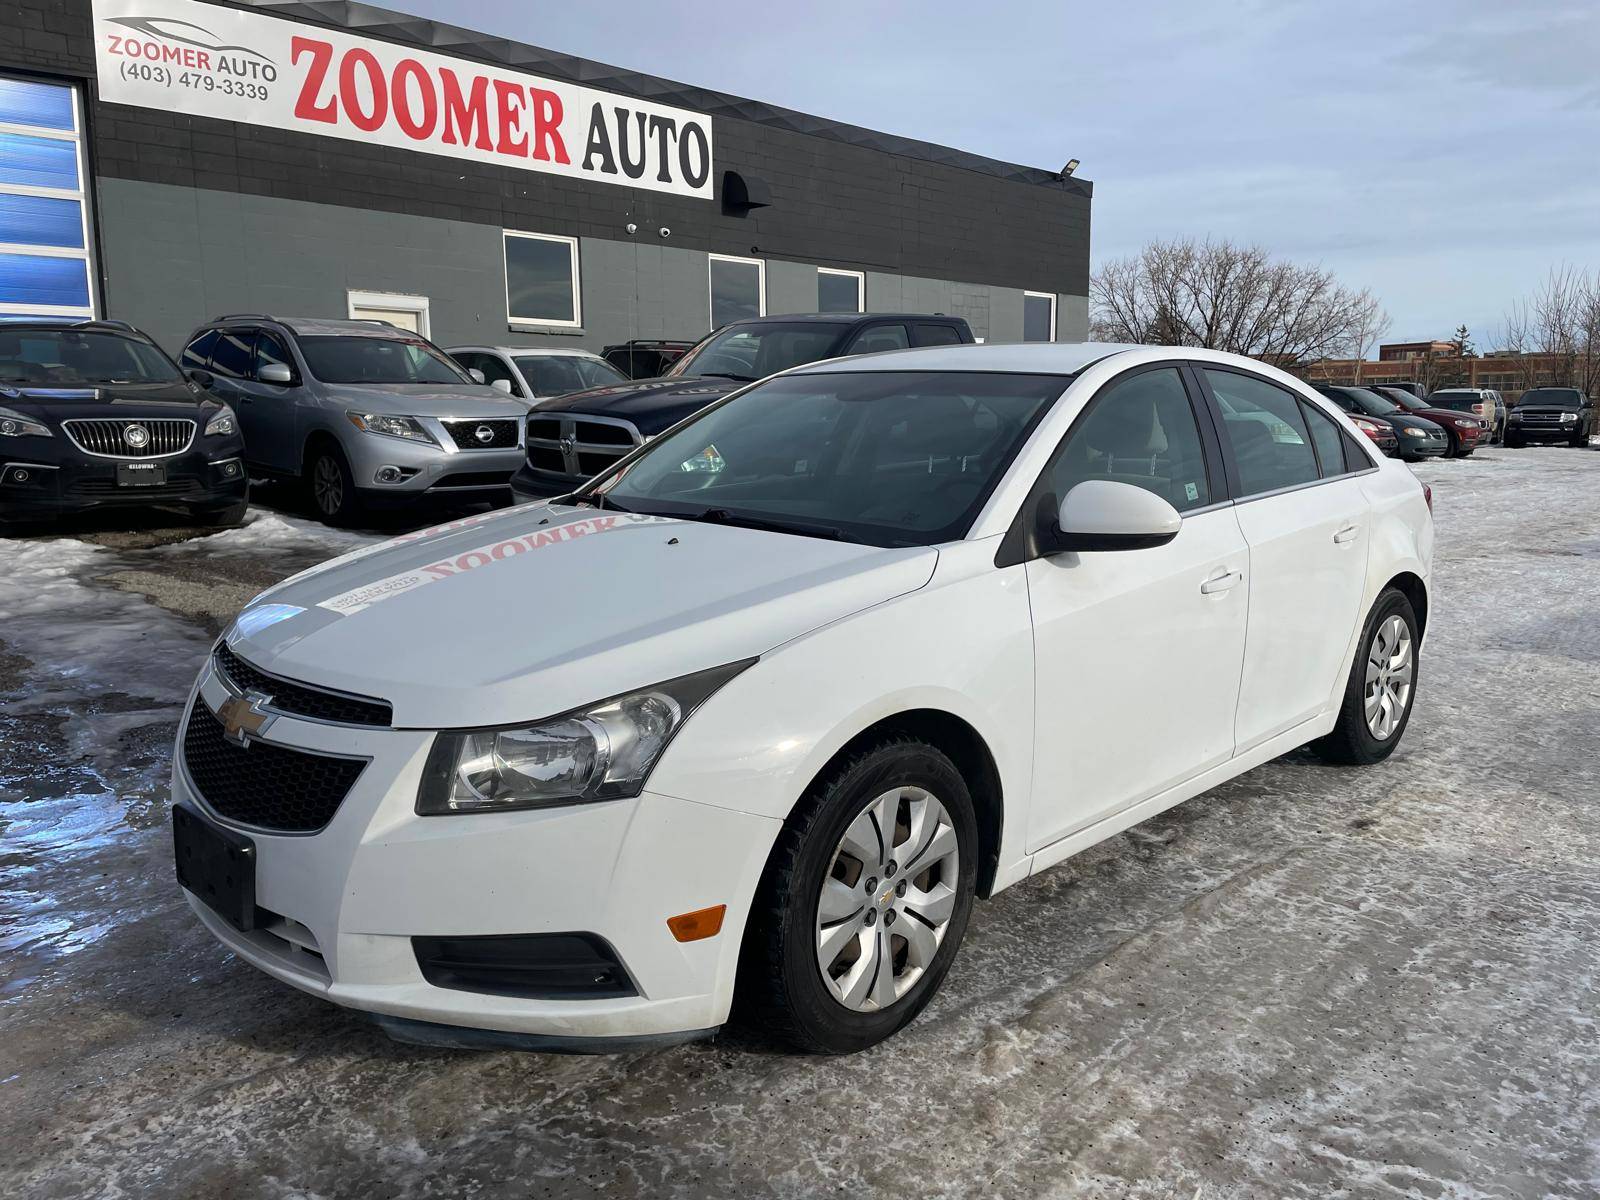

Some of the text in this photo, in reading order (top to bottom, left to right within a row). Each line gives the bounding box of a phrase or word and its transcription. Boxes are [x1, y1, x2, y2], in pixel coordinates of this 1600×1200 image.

[107, 35, 277, 82] ZOOMER AUTO
[120, 61, 268, 101] (403) 479-3339
[291, 35, 710, 189] ZOOMER AUTO
